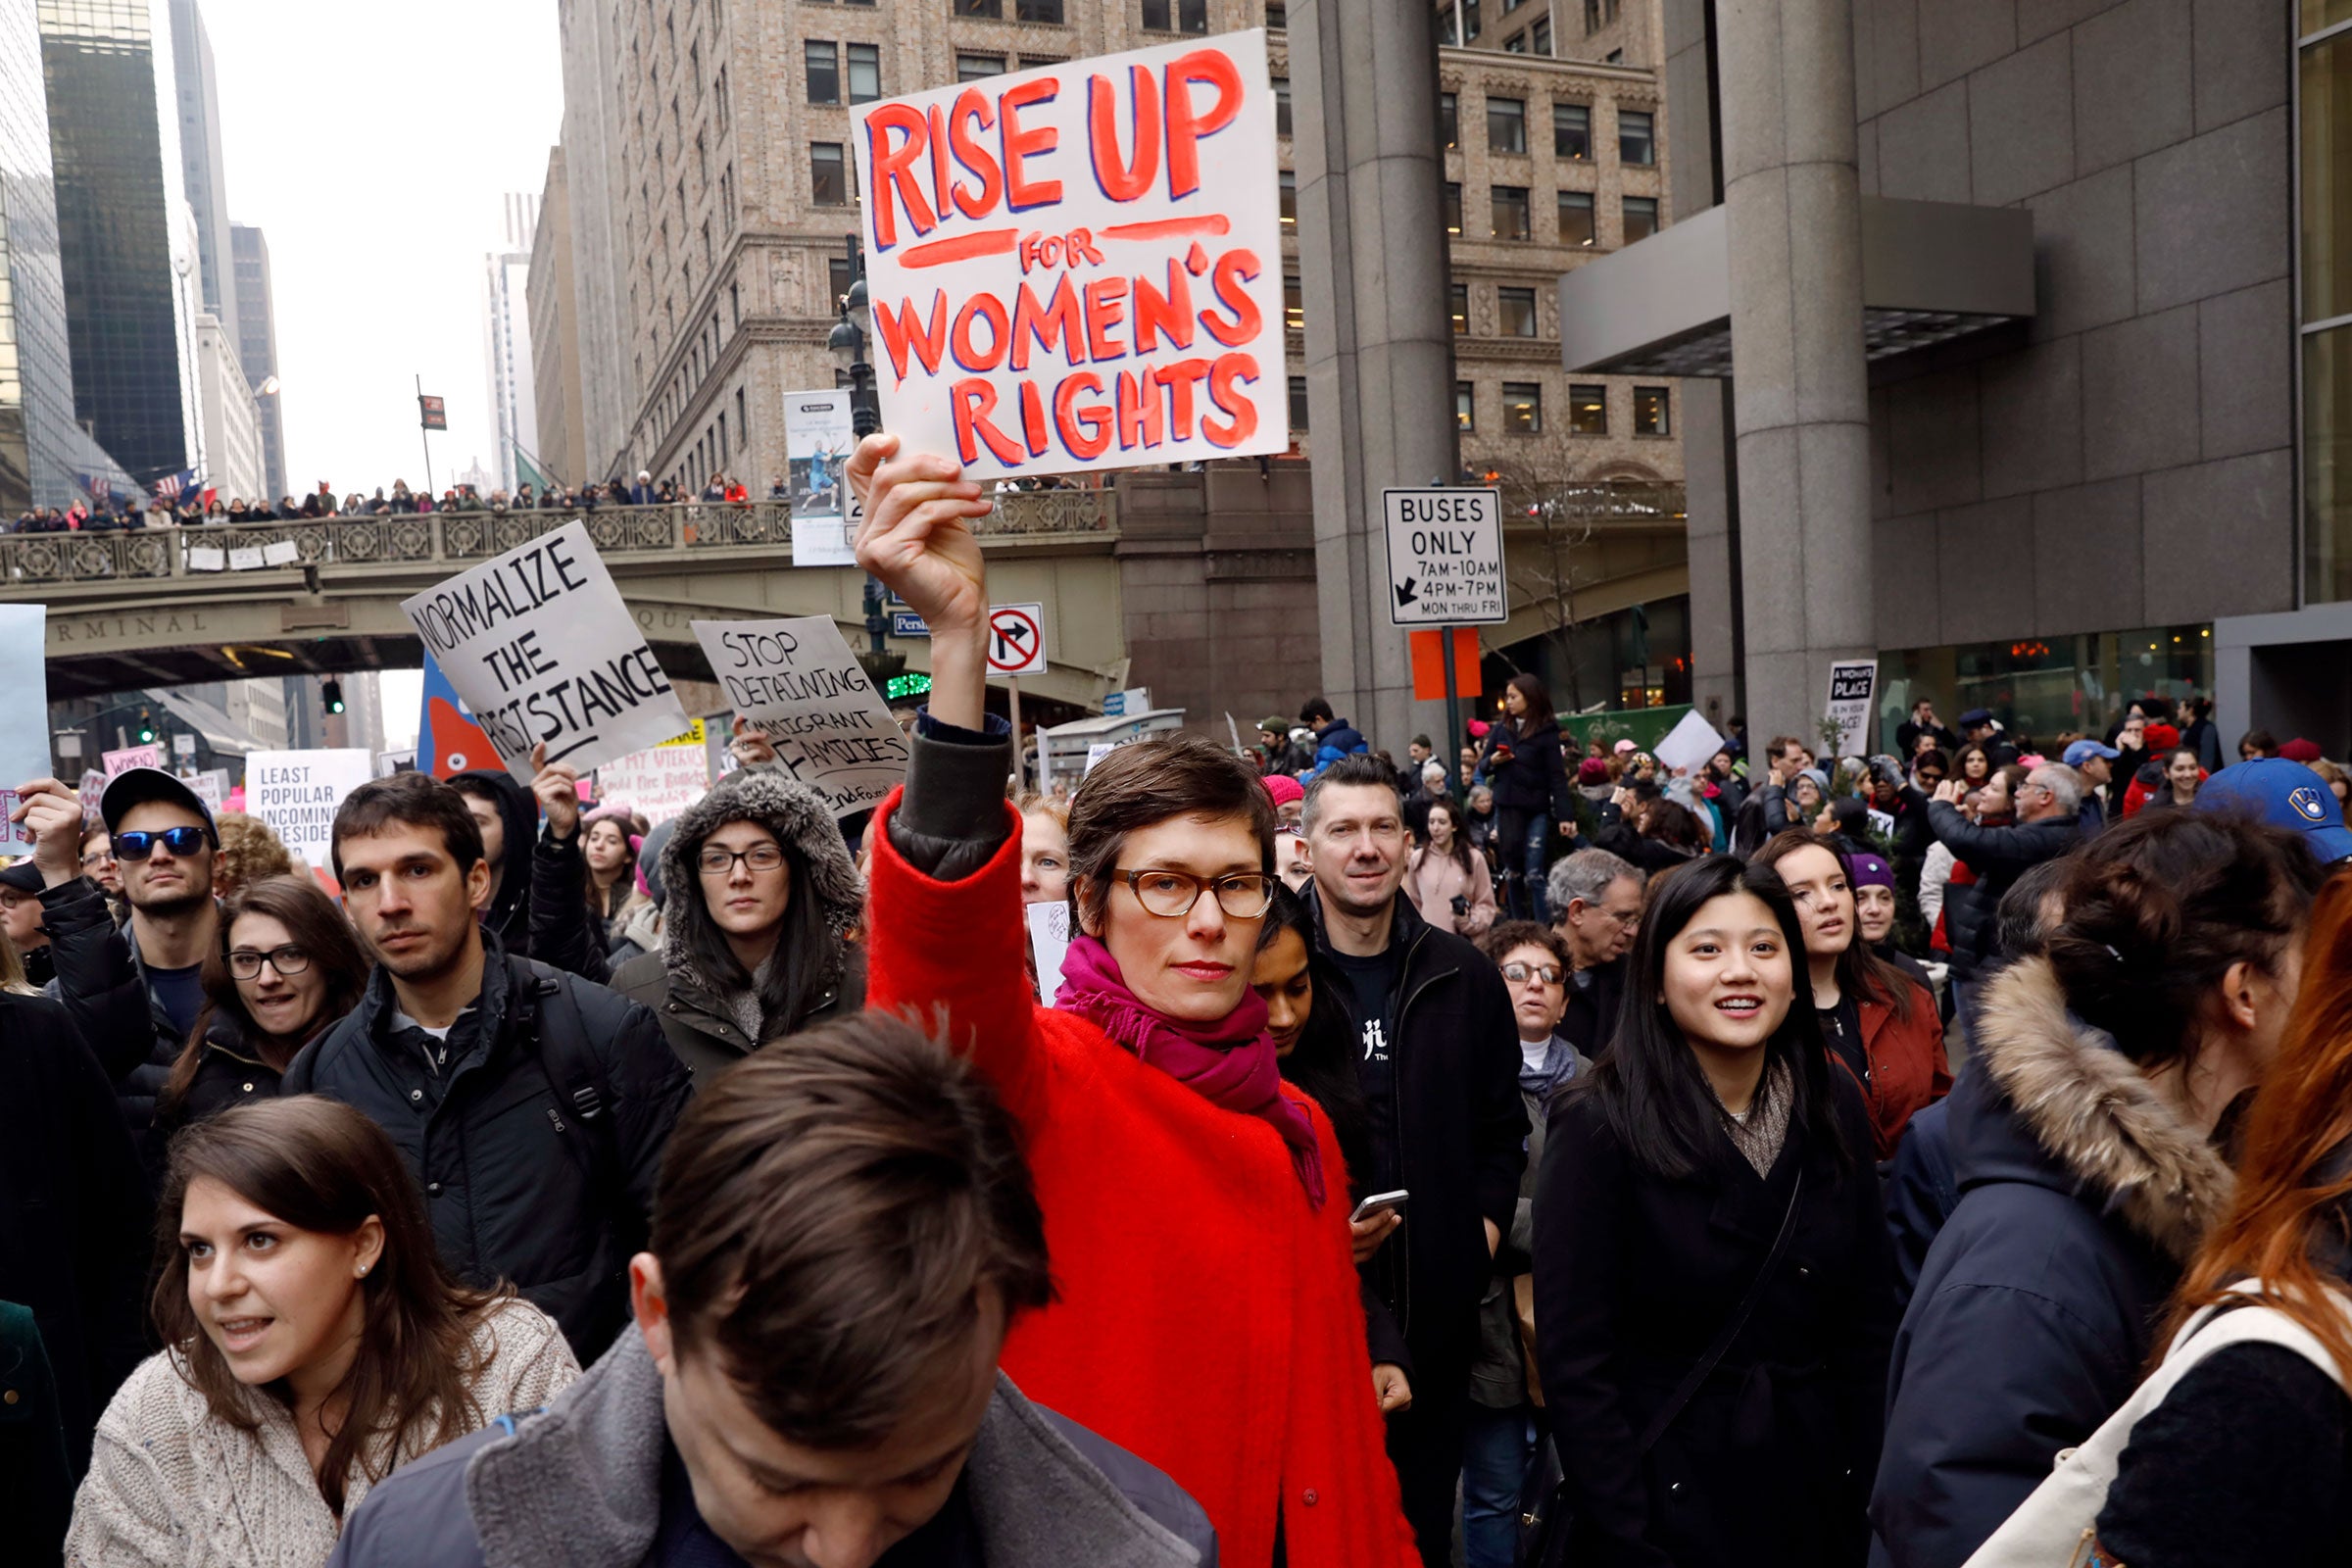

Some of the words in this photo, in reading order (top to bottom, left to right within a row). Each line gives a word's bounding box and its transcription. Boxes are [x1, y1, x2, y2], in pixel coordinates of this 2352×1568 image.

[864, 77, 1062, 252] RISE
[1088, 48, 1245, 203] UP
[1020, 226, 1105, 275] FOR
[872, 240, 1262, 383] WOMEN'S
[950, 352, 1260, 468] RIGHTS
[1400, 499, 1483, 522] BUSES
[1412, 530, 1476, 555] ONLY
[1418, 561, 1498, 576] 7AM-10AM
[412, 536, 588, 659] NORMALIZE
[1423, 580, 1496, 597] 4PM-7PM
[1421, 602, 1447, 614] MON
[1451, 603, 1478, 613] THRU
[1482, 600, 1500, 613] FRI
[45, 613, 207, 643] RMINAL
[897, 614, 929, 630] Persh
[482, 630, 559, 692] THE
[722, 631, 798, 667] STOP
[724, 667, 869, 708] DETAINING
[1834, 680, 1869, 697] PLACE
[625, 751, 647, 770] MY
[654, 745, 706, 768] UTERUS
[771, 737, 909, 781] FAMILIES
[261, 766, 311, 785] LEAST
[261, 786, 333, 806] POPULAR
